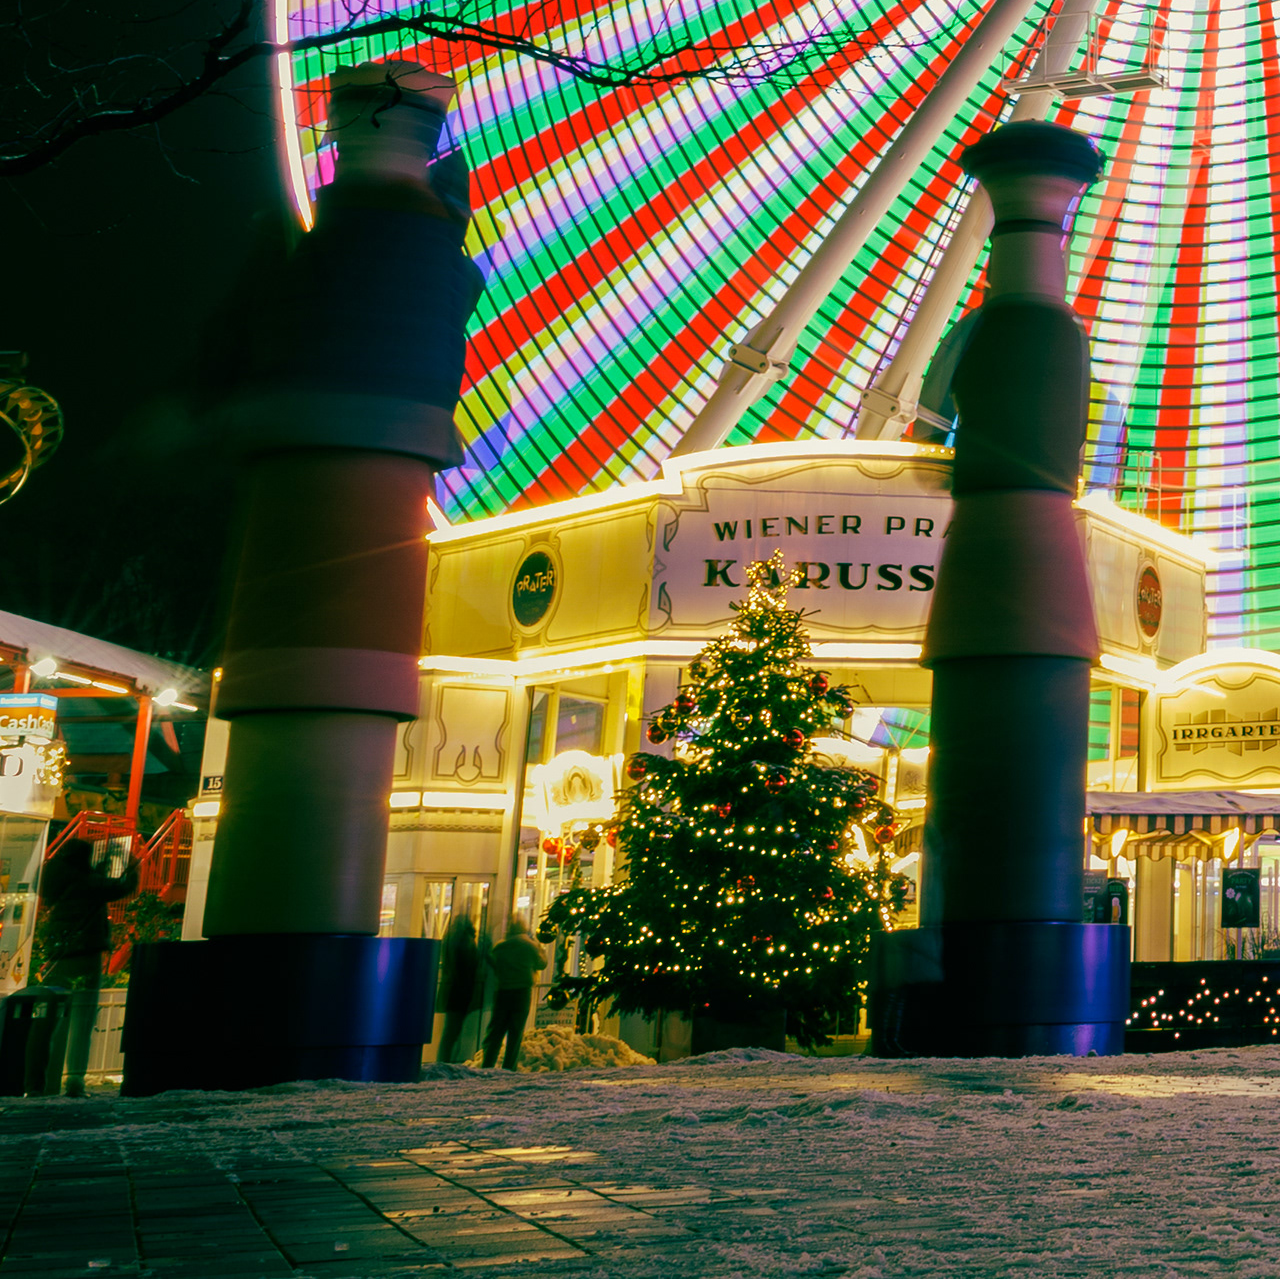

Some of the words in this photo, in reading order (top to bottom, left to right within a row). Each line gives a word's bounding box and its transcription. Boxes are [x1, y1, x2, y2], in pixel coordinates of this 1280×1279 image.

[713, 515, 861, 541] WIENER
[516, 571, 555, 597] PRATER
[0, 714, 38, 729] Cash
[207, 776, 222, 789] 15
